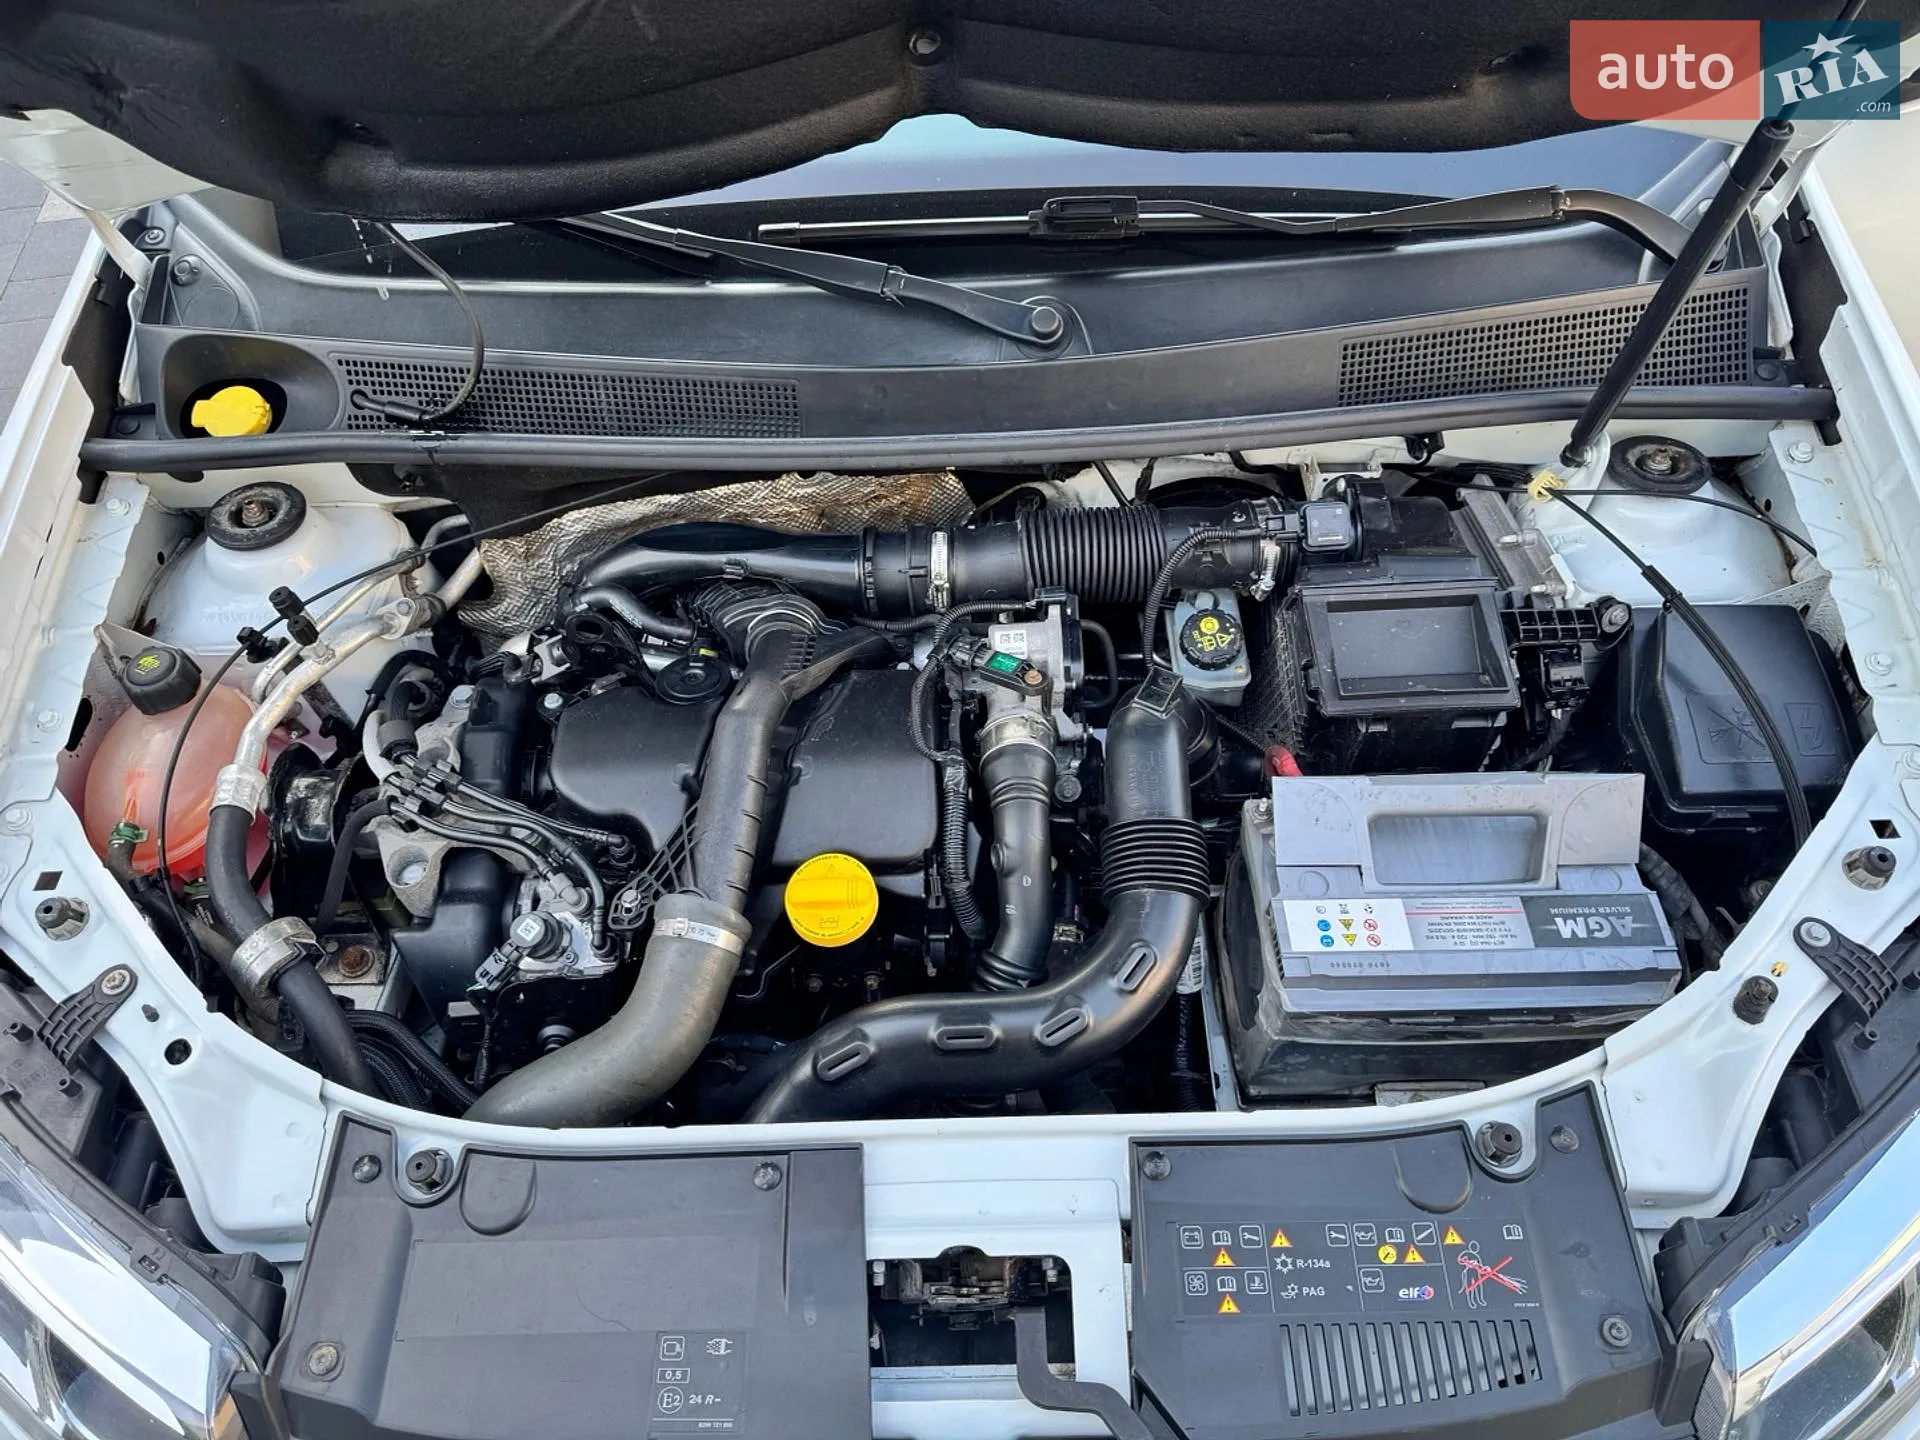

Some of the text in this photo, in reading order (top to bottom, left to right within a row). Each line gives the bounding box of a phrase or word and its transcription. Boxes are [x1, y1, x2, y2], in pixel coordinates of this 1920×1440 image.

[1549, 906, 1596, 914] PREMIUM
[1554, 916, 1633, 938] AGM
[1296, 1259, 1331, 1269] R-134a
[1302, 1286, 1326, 1296] PAG
[1398, 1286, 1421, 1299] elf
[665, 1370, 682, 1381] 0,5
